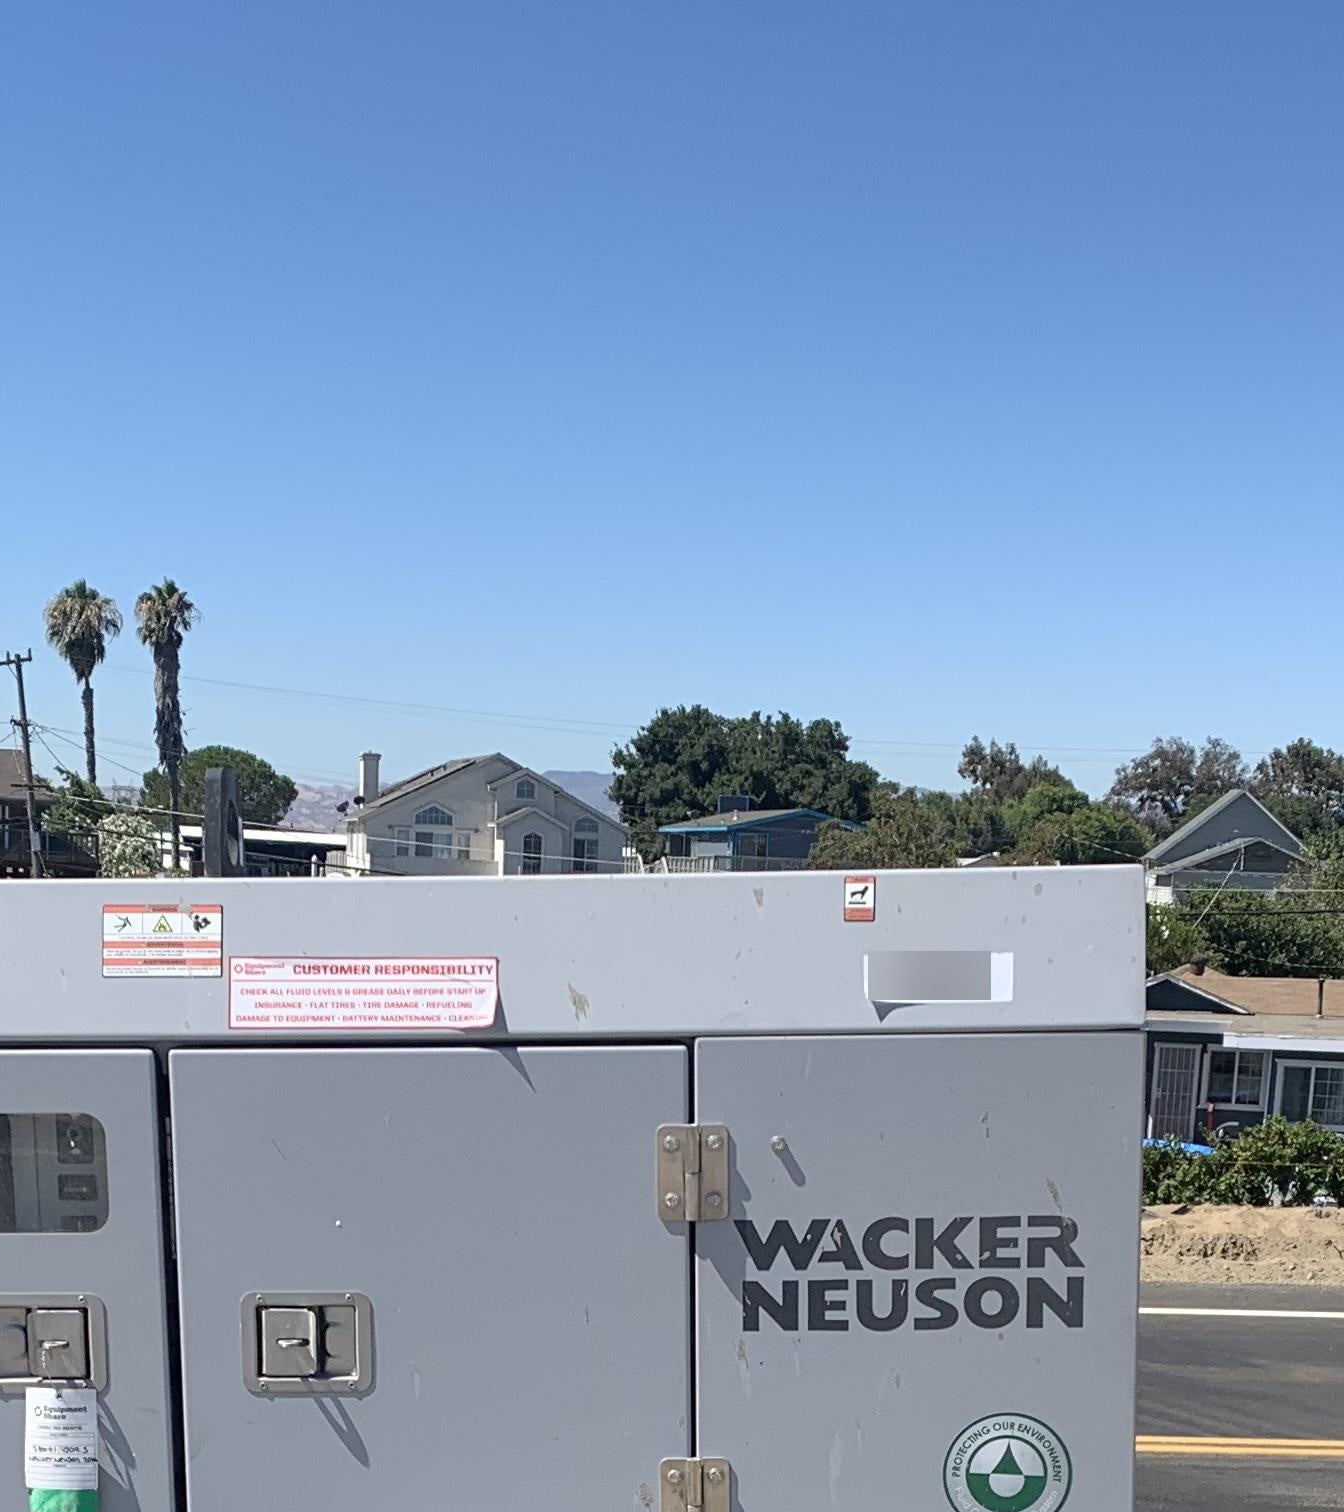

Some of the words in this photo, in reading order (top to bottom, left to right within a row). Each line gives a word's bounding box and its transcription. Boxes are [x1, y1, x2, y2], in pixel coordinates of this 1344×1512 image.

[292, 964, 371, 975] CUSTOMER
[374, 964, 494, 975] RESPONSIBILITY
[240, 987, 269, 996] CHECK
[270, 987, 284, 996] ALL
[286, 987, 311, 996] FLUID
[312, 987, 342, 996] LEVELS
[352, 987, 384, 996] GREASE
[386, 987, 410, 996] DAILY
[412, 987, 444, 996] BEFORE
[446, 987, 472, 996] START
[474, 987, 486, 996] UP
[254, 1001, 303, 1009] INSURANCE
[309, 1001, 328, 1009] FLAT
[331, 1001, 356, 1009] TIRES
[362, 1001, 382, 1009] TIRE
[384, 1001, 419, 1009] DAMAGE
[426, 1001, 473, 1009] REFUELING
[236, 1014, 270, 1022] DAMAGE
[274, 1014, 284, 1022] TO
[286, 1014, 335, 1022] EQUIPMENT
[342, 1014, 378, 1022] BATTERY
[381, 1014, 442, 1022] MAINTENANCE
[733, 1215, 1086, 1271] WACKER
[742, 1276, 1085, 1332] NEUSON
[952, 1425, 991, 1478] PROTECTING
[993, 1421, 1016, 1432] OUR
[1017, 1423, 1062, 1483] ENVIRONMENT
[954, 1486, 973, 1510] Fluid
